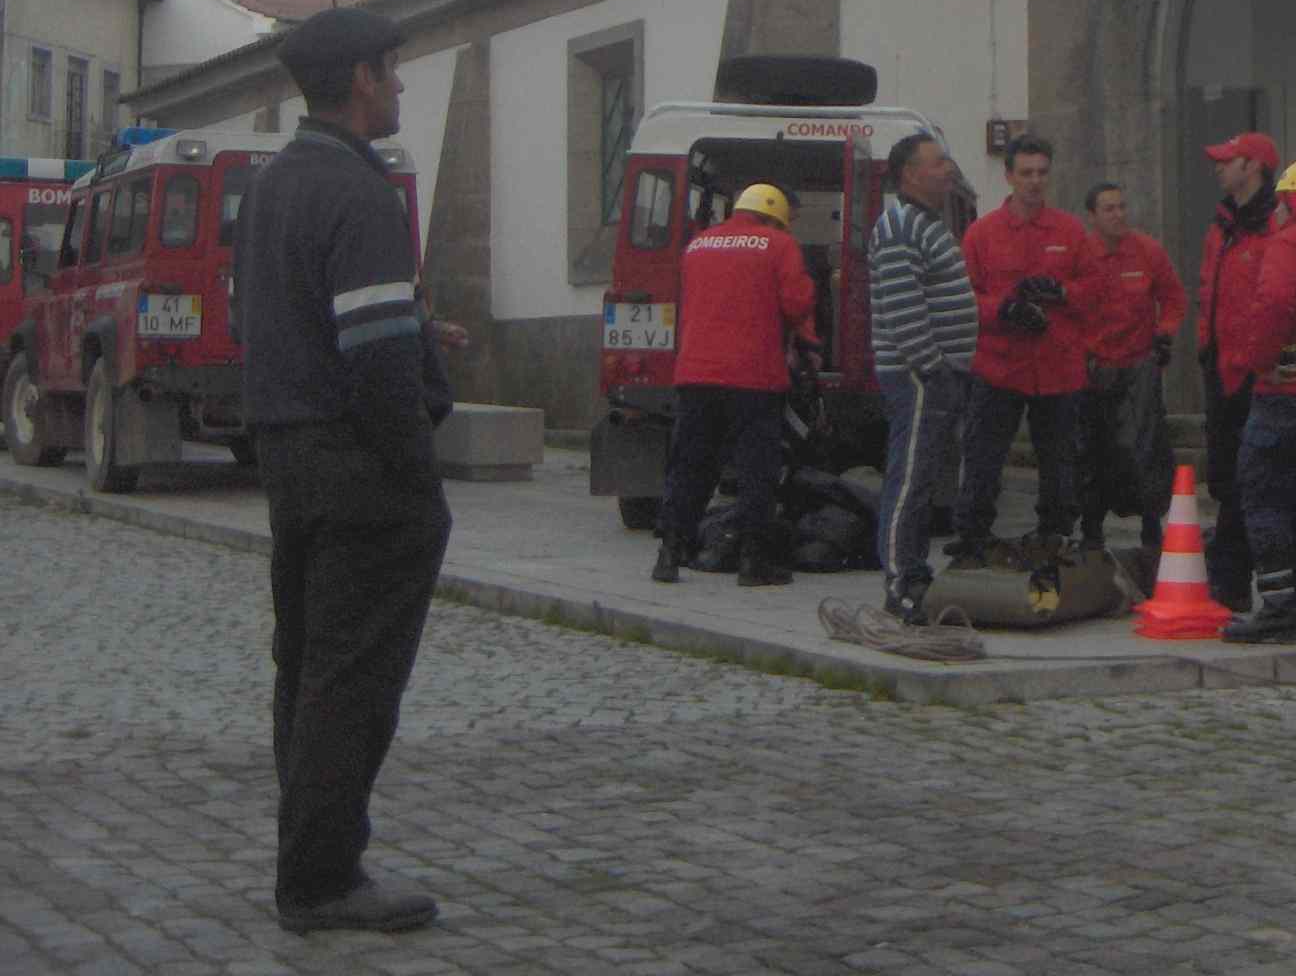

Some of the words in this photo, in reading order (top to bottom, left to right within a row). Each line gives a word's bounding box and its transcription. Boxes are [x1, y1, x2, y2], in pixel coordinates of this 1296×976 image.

[787, 123, 873, 136] COMANDO
[686, 234, 769, 253] BOMBEIROS
[161, 296, 178, 312] 41
[631, 304, 652, 322] 21
[144, 316, 160, 331] 10
